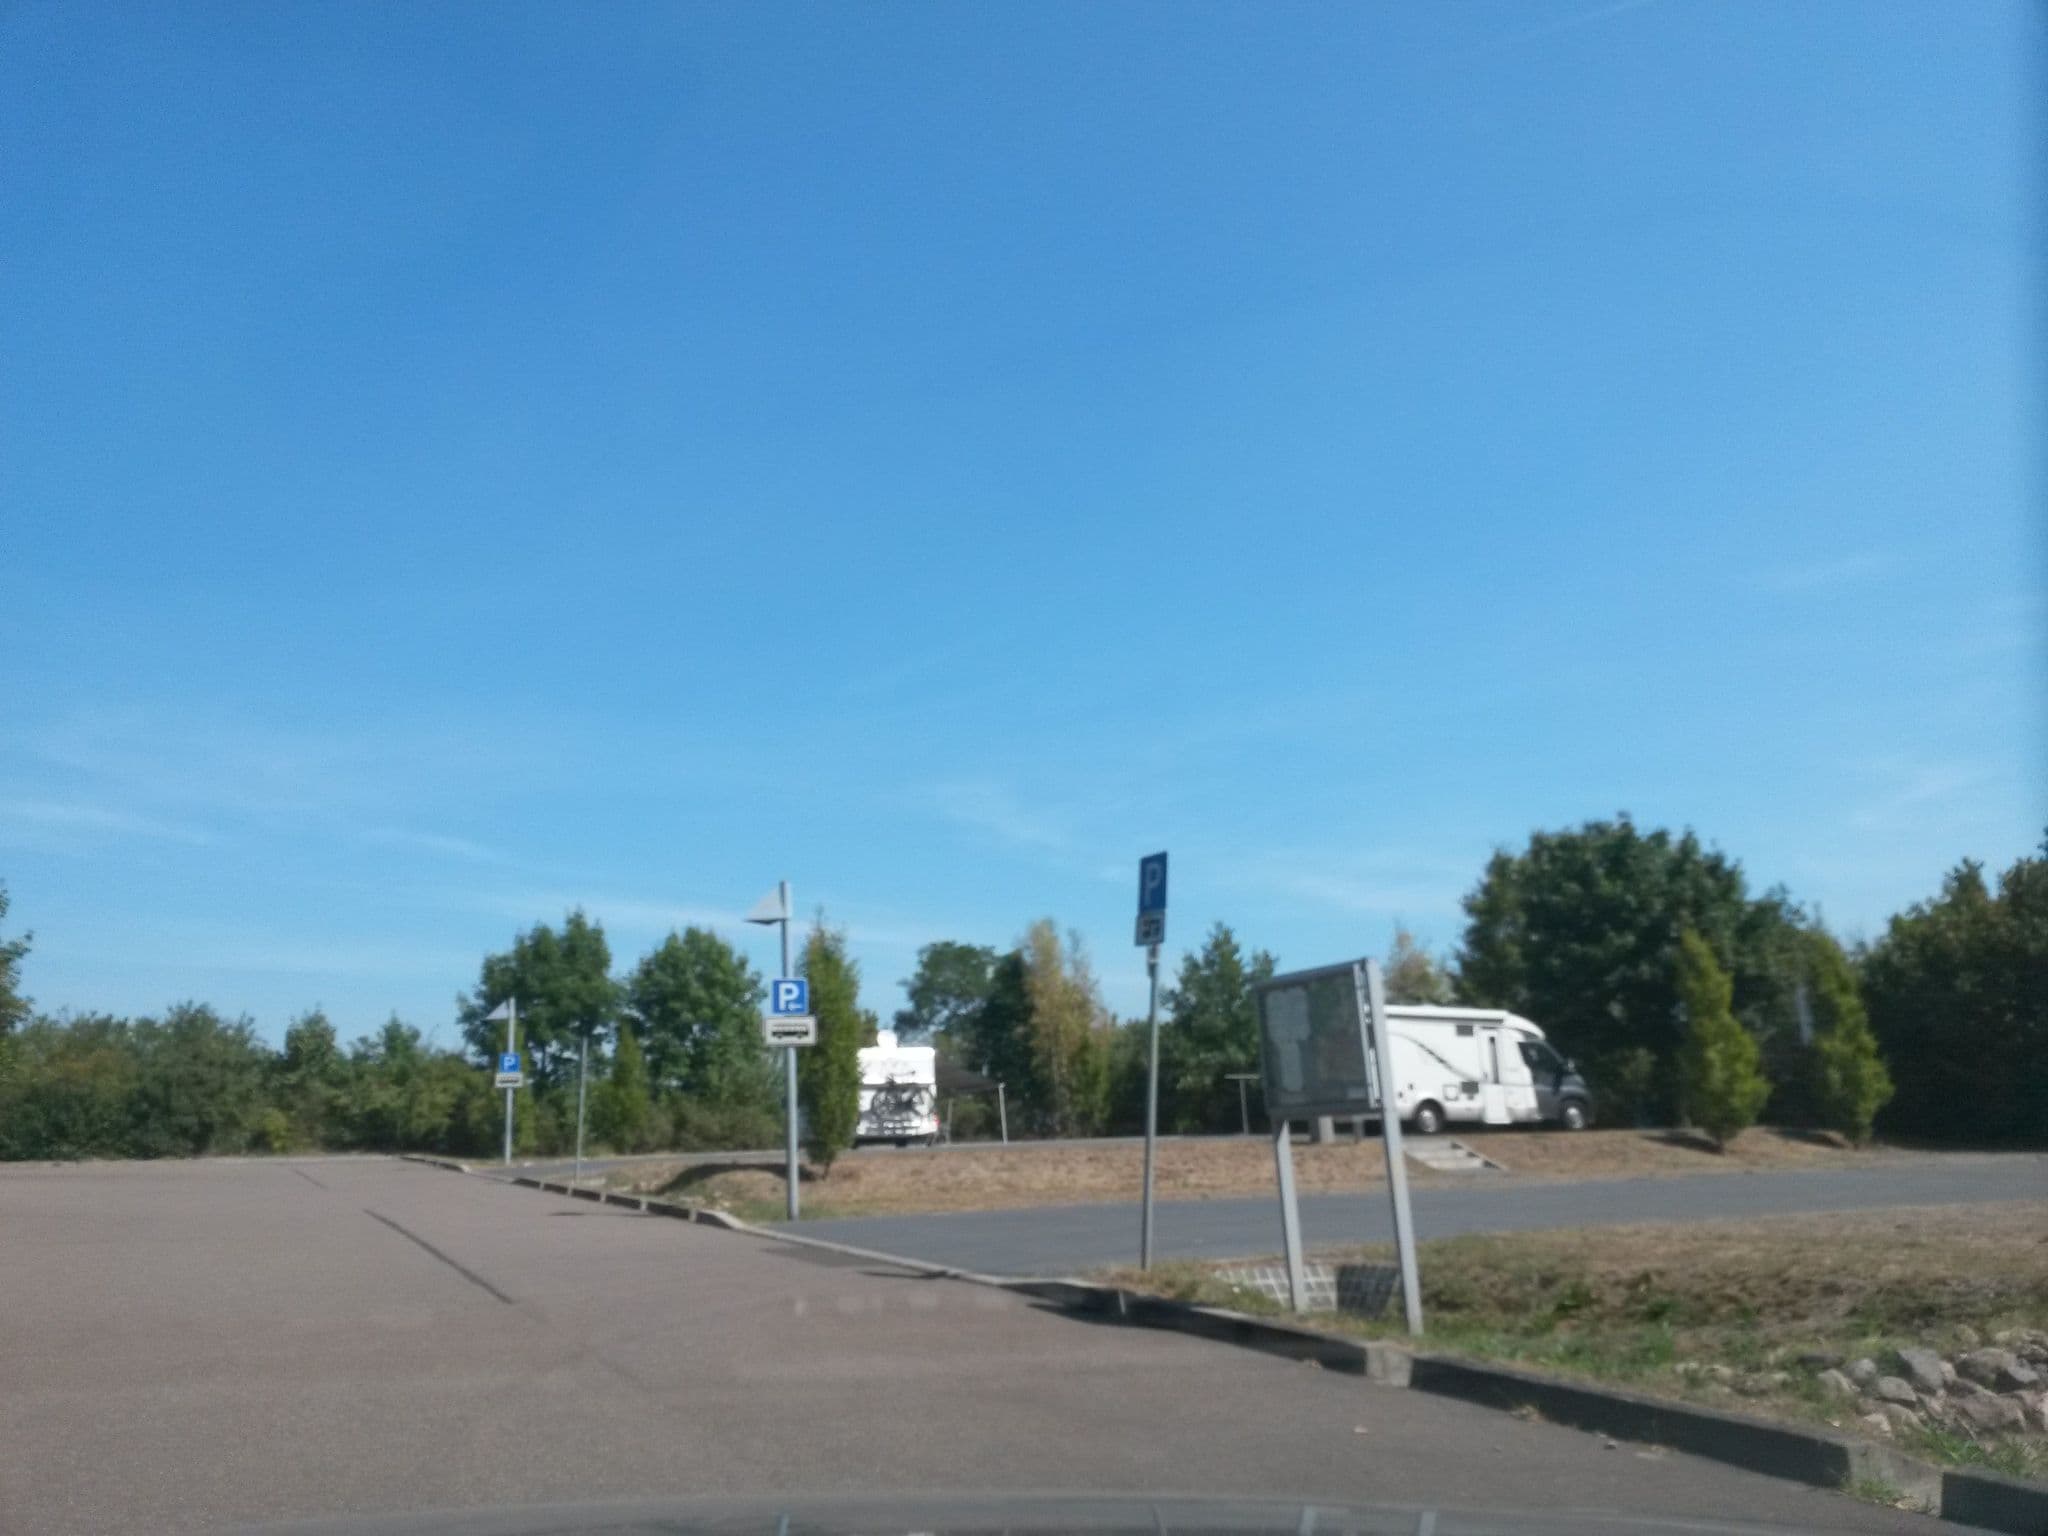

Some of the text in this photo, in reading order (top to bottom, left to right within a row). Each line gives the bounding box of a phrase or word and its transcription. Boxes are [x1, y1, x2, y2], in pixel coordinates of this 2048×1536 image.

[1144, 862, 1161, 908] P
[778, 982, 800, 1010] P
[503, 1055, 517, 1073] P
